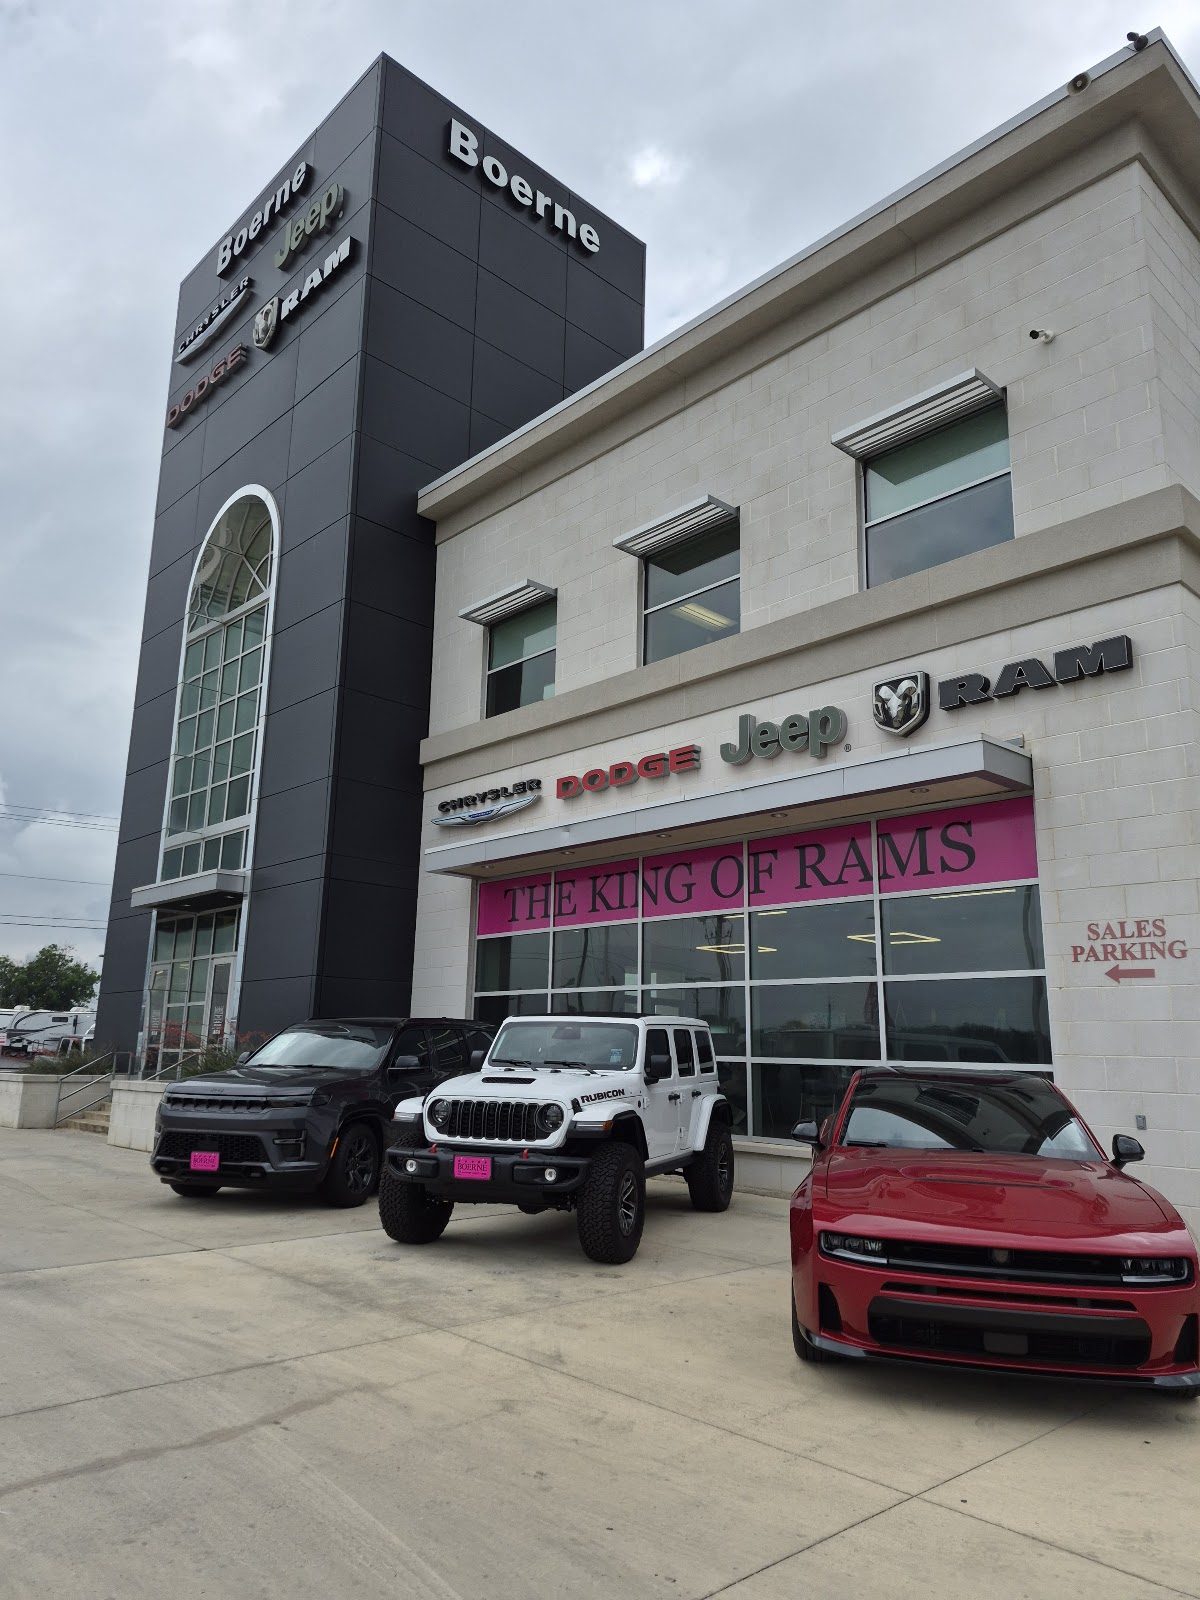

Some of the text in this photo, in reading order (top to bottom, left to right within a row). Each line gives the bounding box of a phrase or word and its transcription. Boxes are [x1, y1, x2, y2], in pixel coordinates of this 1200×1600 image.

[216, 161, 309, 277] Boerne
[449, 118, 600, 253] Boerne
[273, 183, 344, 271] Jeep
[178, 276, 251, 353] CHRYSLER
[281, 236, 352, 321] RAM
[167, 342, 248, 428] DODGE
[938, 634, 1134, 711] RAM
[556, 745, 701, 800] DODGE
[720, 705, 848, 766] Jeep
[438, 778, 542, 812] CHRYSLER
[504, 820, 976, 923] THE KING OF RAMS
[1070, 939, 1189, 963] PARKING
[1087, 918, 1167, 941] SALES
[580, 1088, 626, 1104] RUBICON
[457, 1162, 488, 1172] BOERNE
